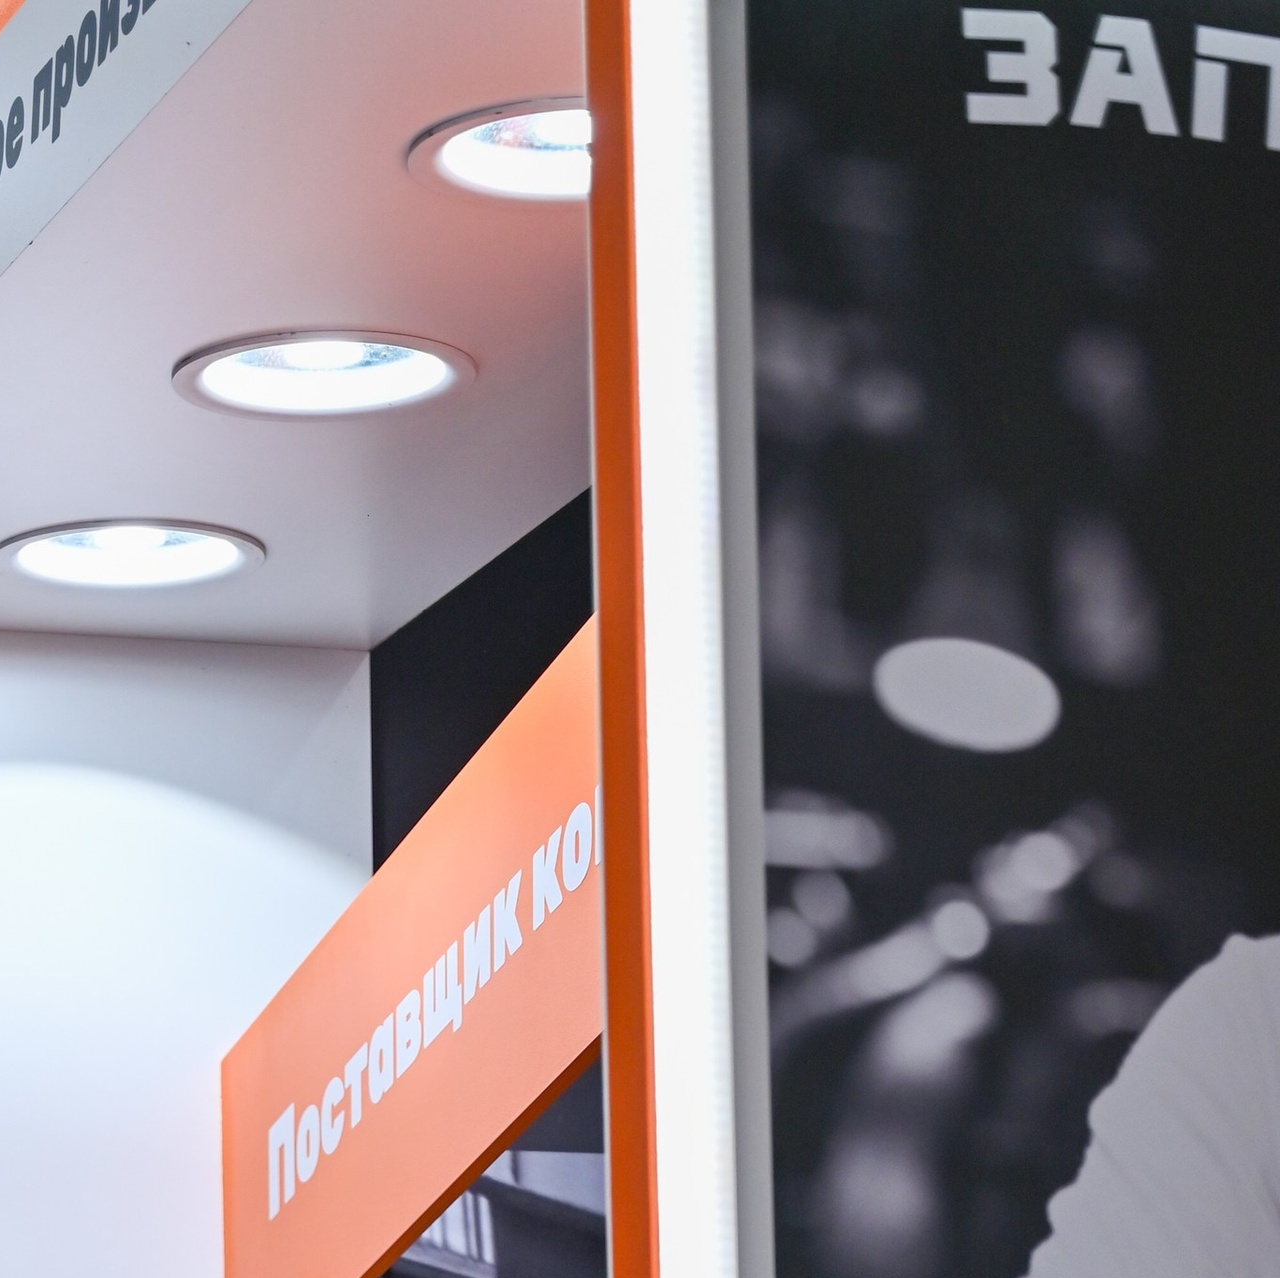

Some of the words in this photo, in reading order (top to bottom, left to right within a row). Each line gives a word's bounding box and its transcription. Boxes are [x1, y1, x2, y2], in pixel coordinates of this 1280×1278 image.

[31, 0, 157, 144] прои
[268, 869, 522, 1221] Поставщик
[532, 783, 604, 931] ко
